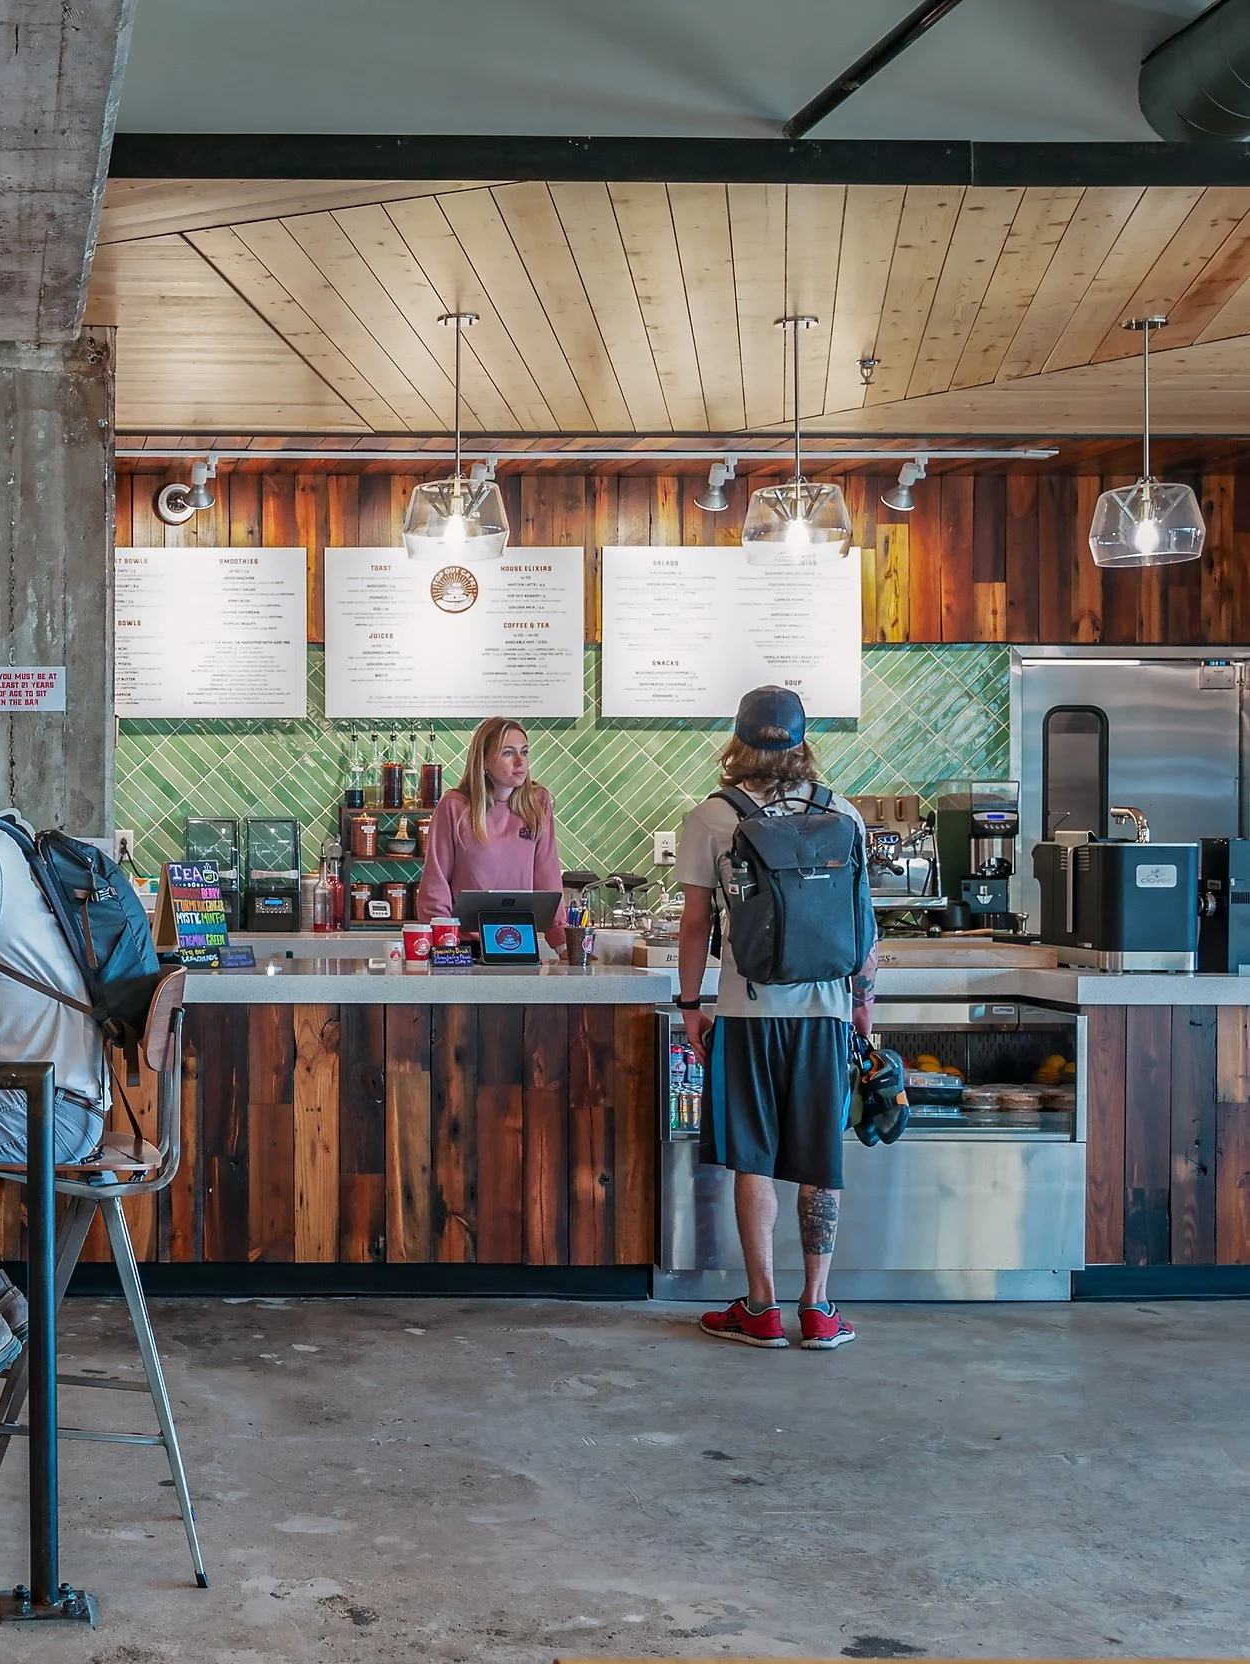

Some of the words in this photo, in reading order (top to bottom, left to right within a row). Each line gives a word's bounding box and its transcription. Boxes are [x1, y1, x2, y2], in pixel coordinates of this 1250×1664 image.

[433, 571, 444, 585] TOP
[444, 567, 460, 575] OUT
[21, 681, 29, 689] 21
[31, 681, 54, 689] YEARS
[169, 864, 203, 882] TEA
[1140, 874, 1171, 884] clover
[201, 887, 220, 900] BERRY
[174, 899, 206, 912] TURMERIC
[176, 912, 202, 925] MYSTIC
[201, 912, 221, 925] MINT
[180, 934, 207, 948] JASMINE
[206, 933, 225, 946] GREEN
